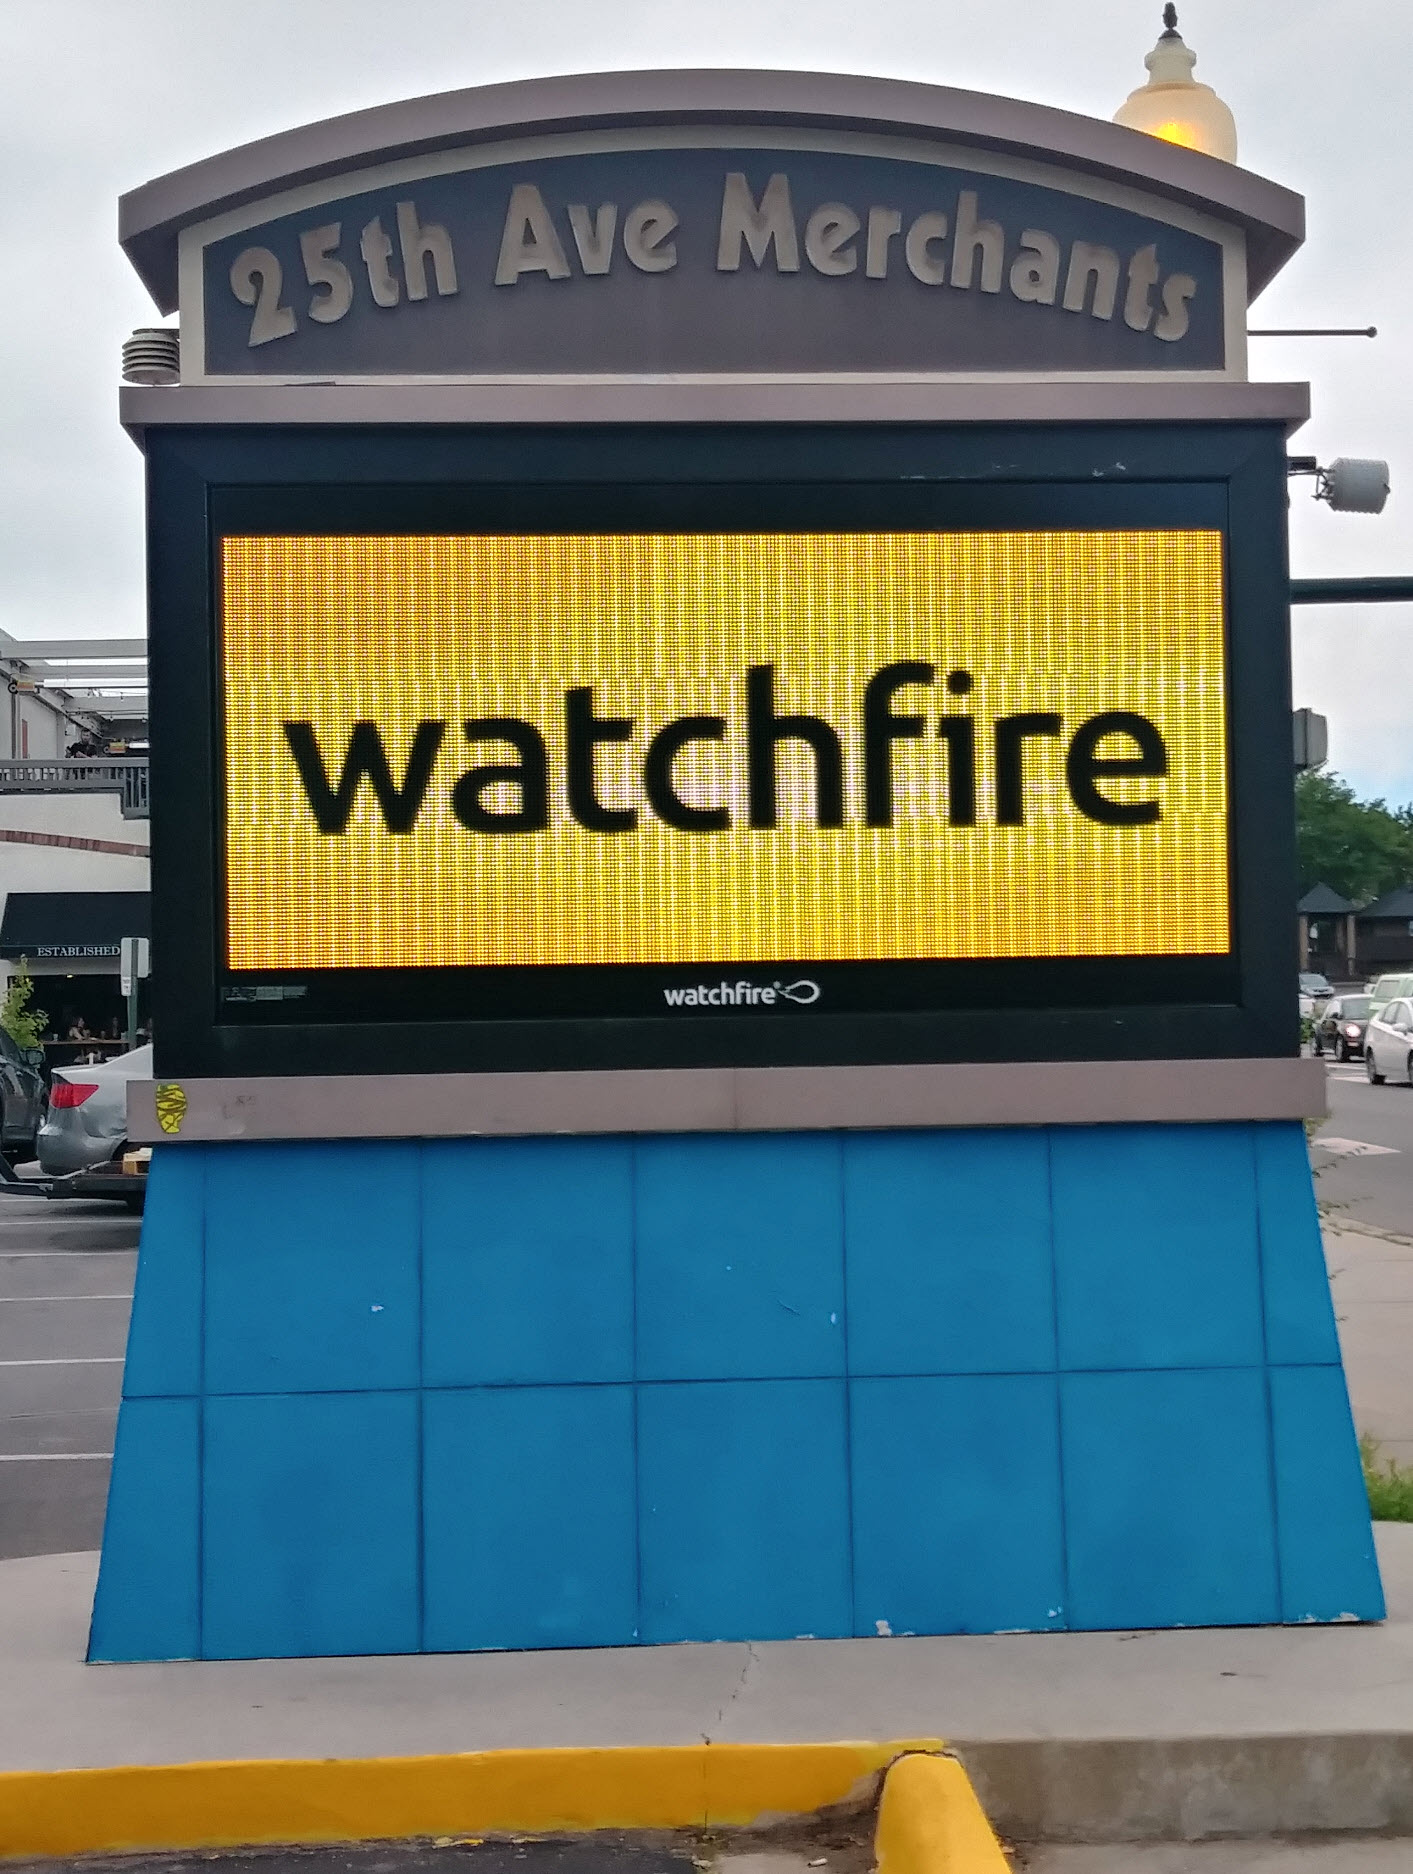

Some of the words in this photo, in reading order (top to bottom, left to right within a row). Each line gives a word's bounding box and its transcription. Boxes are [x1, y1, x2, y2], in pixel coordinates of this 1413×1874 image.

[229, 200, 459, 348] 25th
[494, 183, 679, 287] Ave
[716, 172, 1197, 342] Merchants
[283, 662, 1169, 836] watchfire
[37, 946, 120, 956] ESTABLISHED
[663, 981, 776, 1006] watchfire
